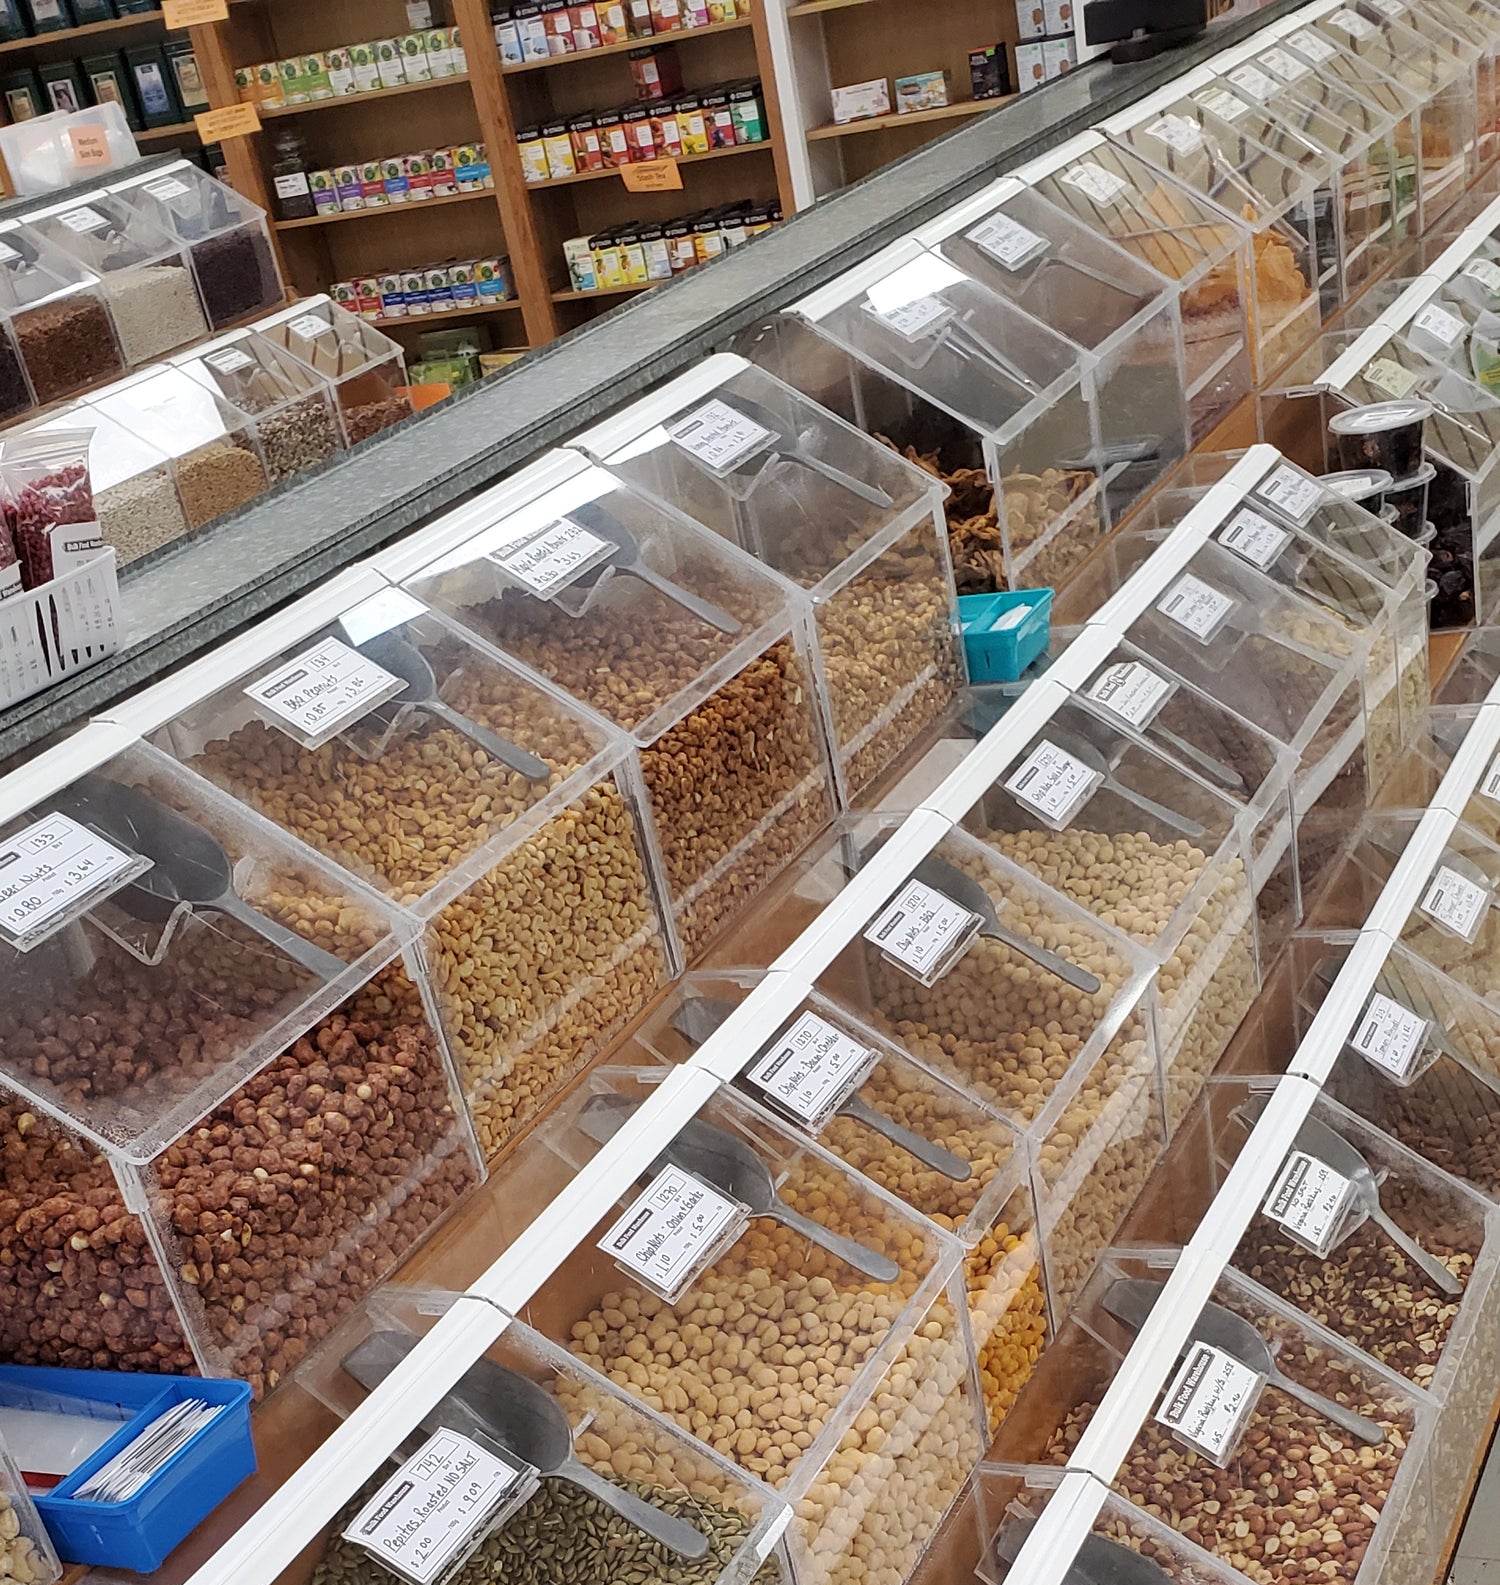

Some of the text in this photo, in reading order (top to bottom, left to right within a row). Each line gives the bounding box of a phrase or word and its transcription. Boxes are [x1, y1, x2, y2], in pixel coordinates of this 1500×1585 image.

[309, 653, 330, 668] 134
[29, 833, 54, 848] 133
[18, 863, 54, 886] Nuts
[794, 1030, 812, 1046] 1270
[655, 1185, 677, 1203] 1270
[1168, 1356, 1207, 1418] Bulk Food Warehouse
[416, 1453, 444, 1473] 742
[412, 1482, 448, 1518] Roasted
[442, 1471, 460, 1486] NO
[454, 1450, 476, 1474] SALT
